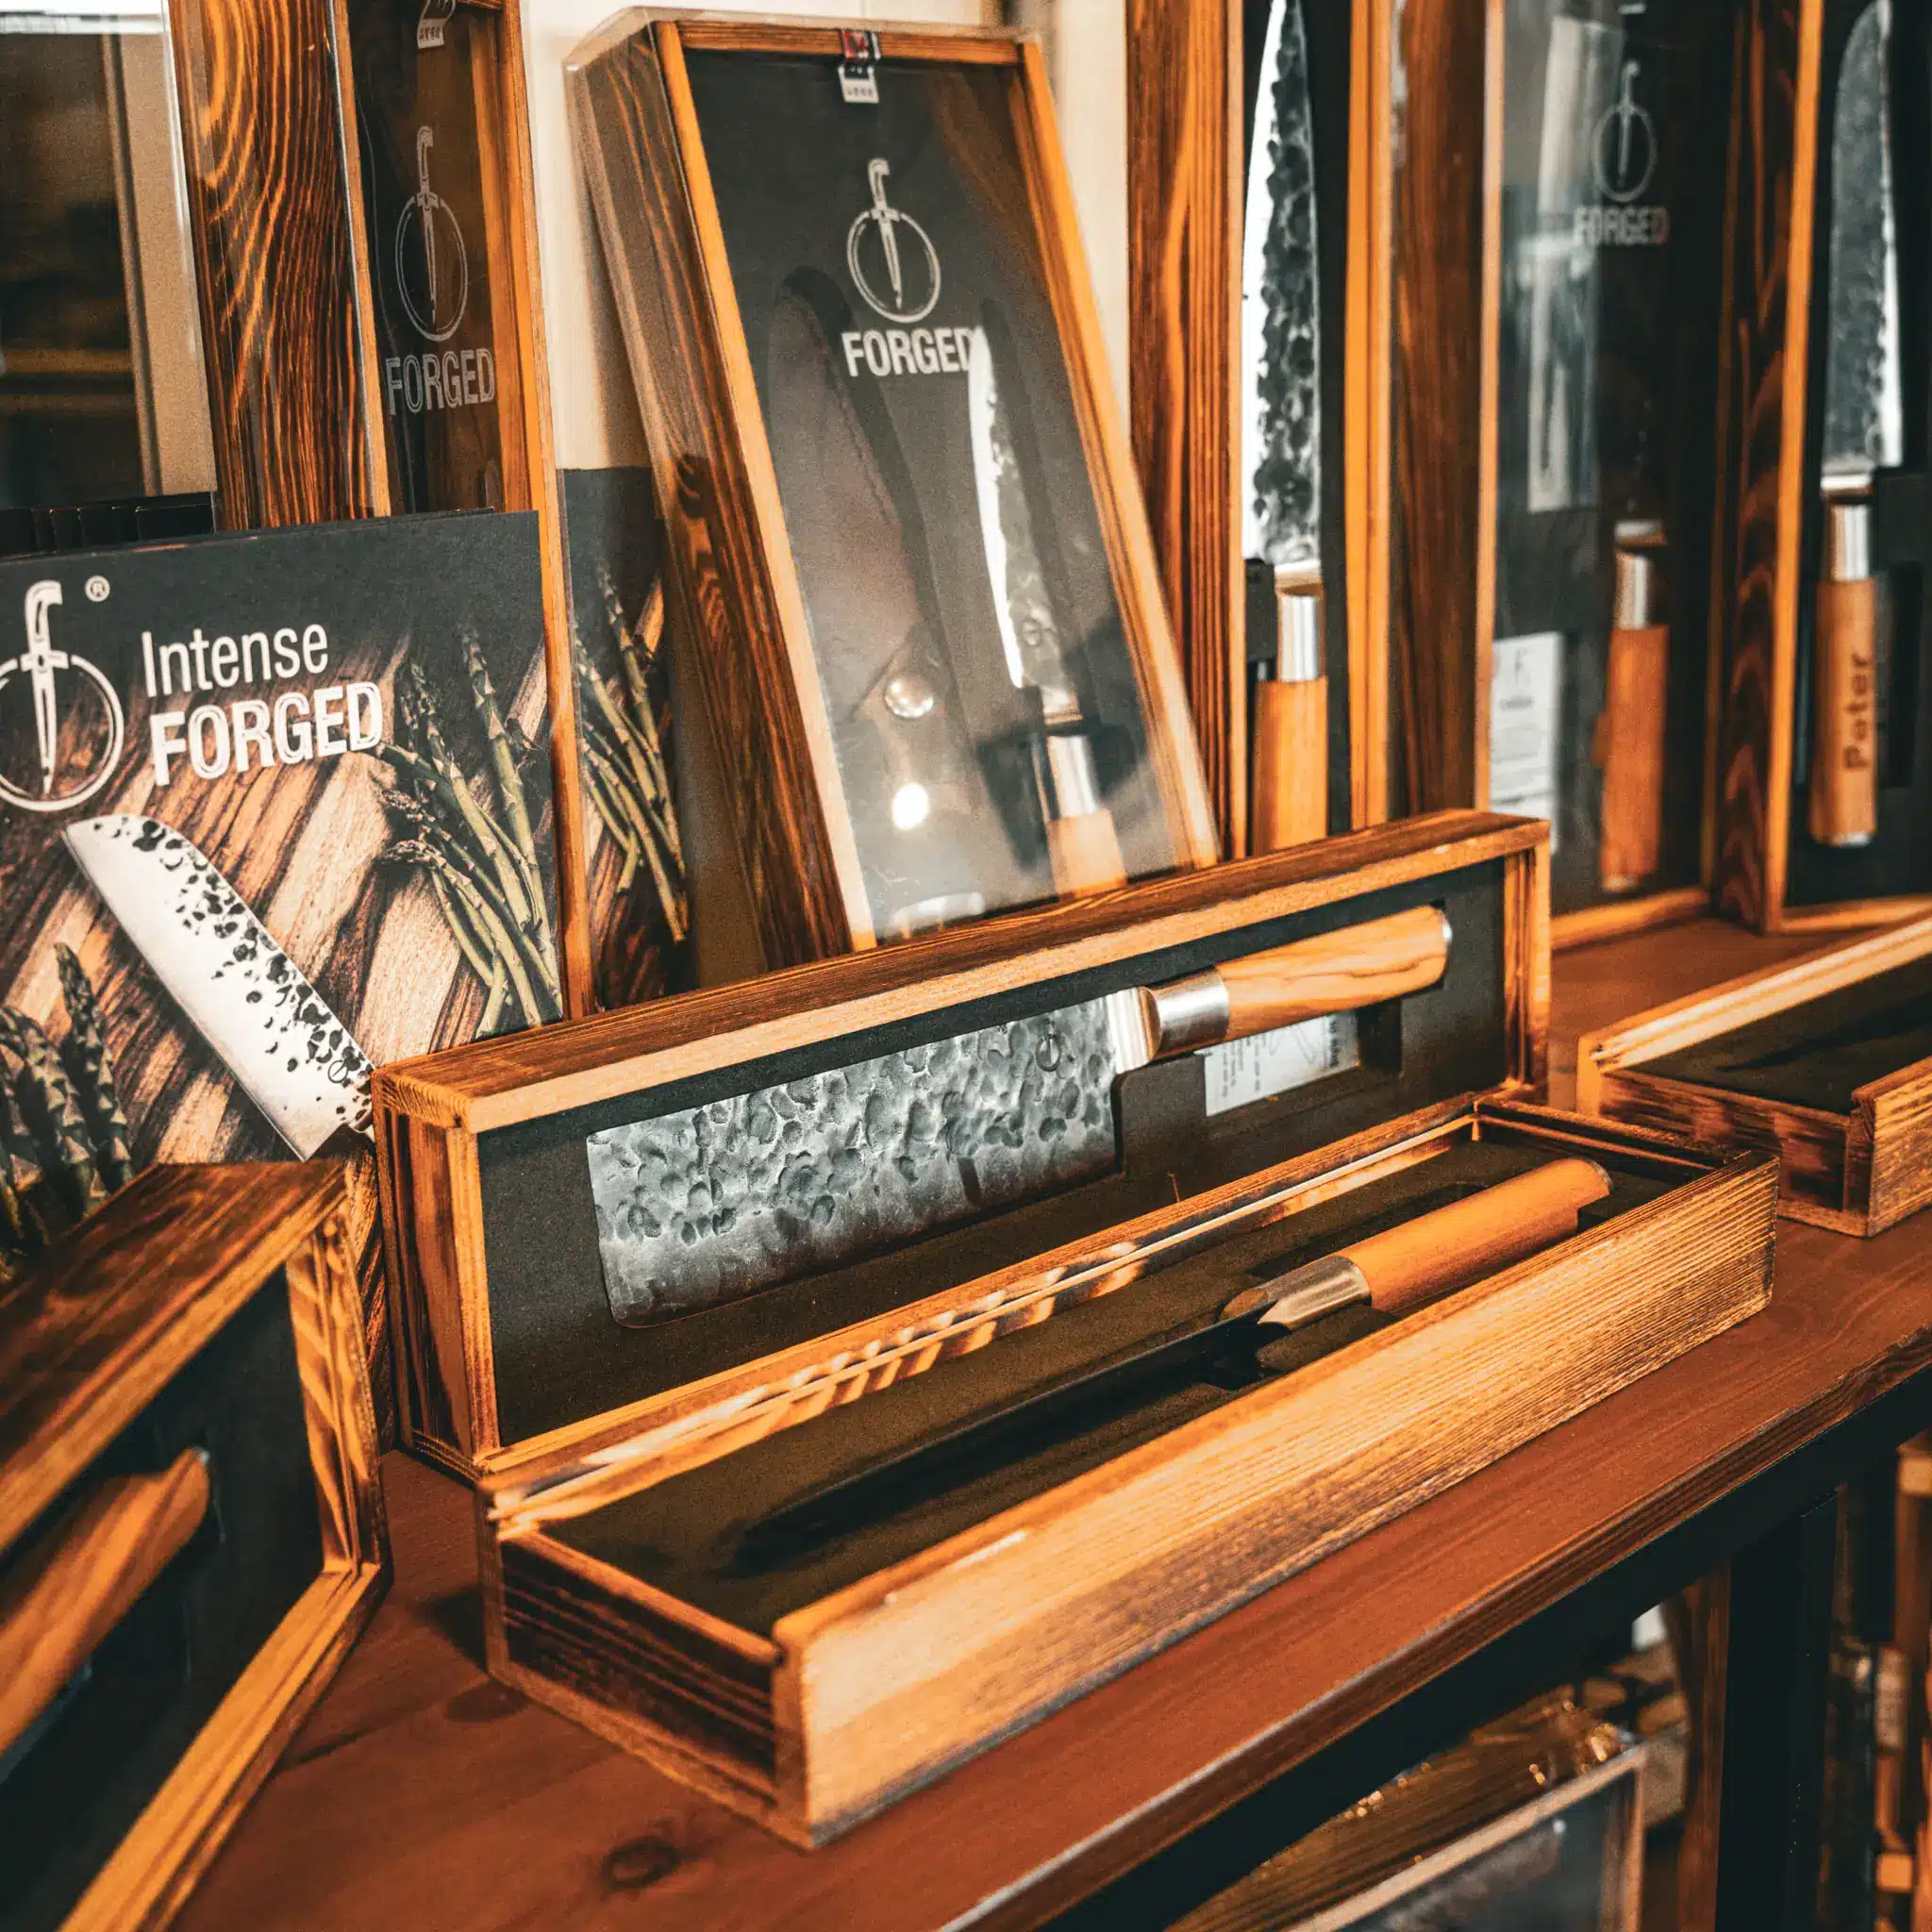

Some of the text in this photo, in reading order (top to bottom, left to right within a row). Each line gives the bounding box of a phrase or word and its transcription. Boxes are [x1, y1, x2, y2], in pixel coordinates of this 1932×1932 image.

[1573, 205, 1671, 245] FORGED
[385, 347, 495, 415] FORGED
[841, 326, 974, 377] FORGED
[142, 624, 328, 697] Intense
[150, 682, 383, 786] FORGED
